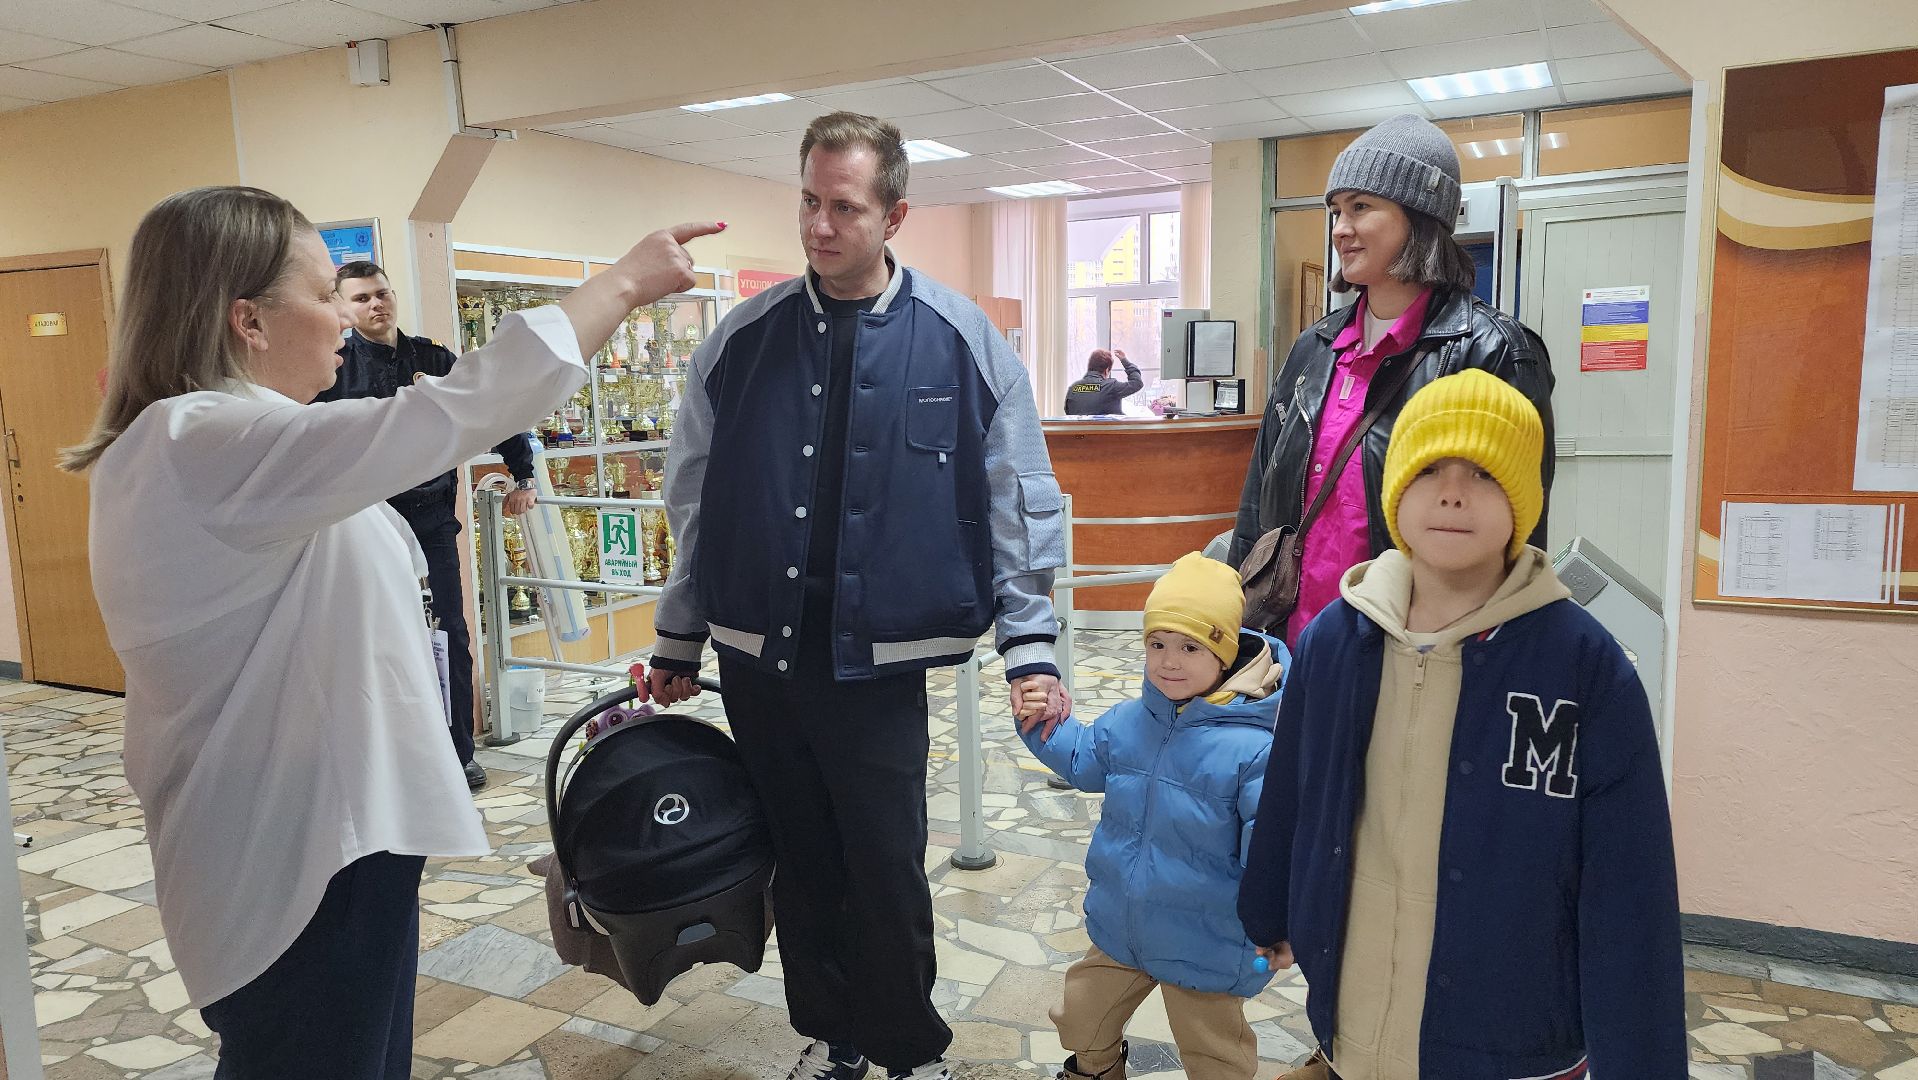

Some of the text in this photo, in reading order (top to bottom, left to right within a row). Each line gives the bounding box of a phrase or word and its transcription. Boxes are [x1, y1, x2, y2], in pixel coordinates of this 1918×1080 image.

[1073, 385, 1099, 393] ОХРАНА
[604, 558, 638, 568] АВАРИЙНЫЙ
[611, 568, 632, 578] ВЫХОД
[1502, 692, 1579, 798] M
